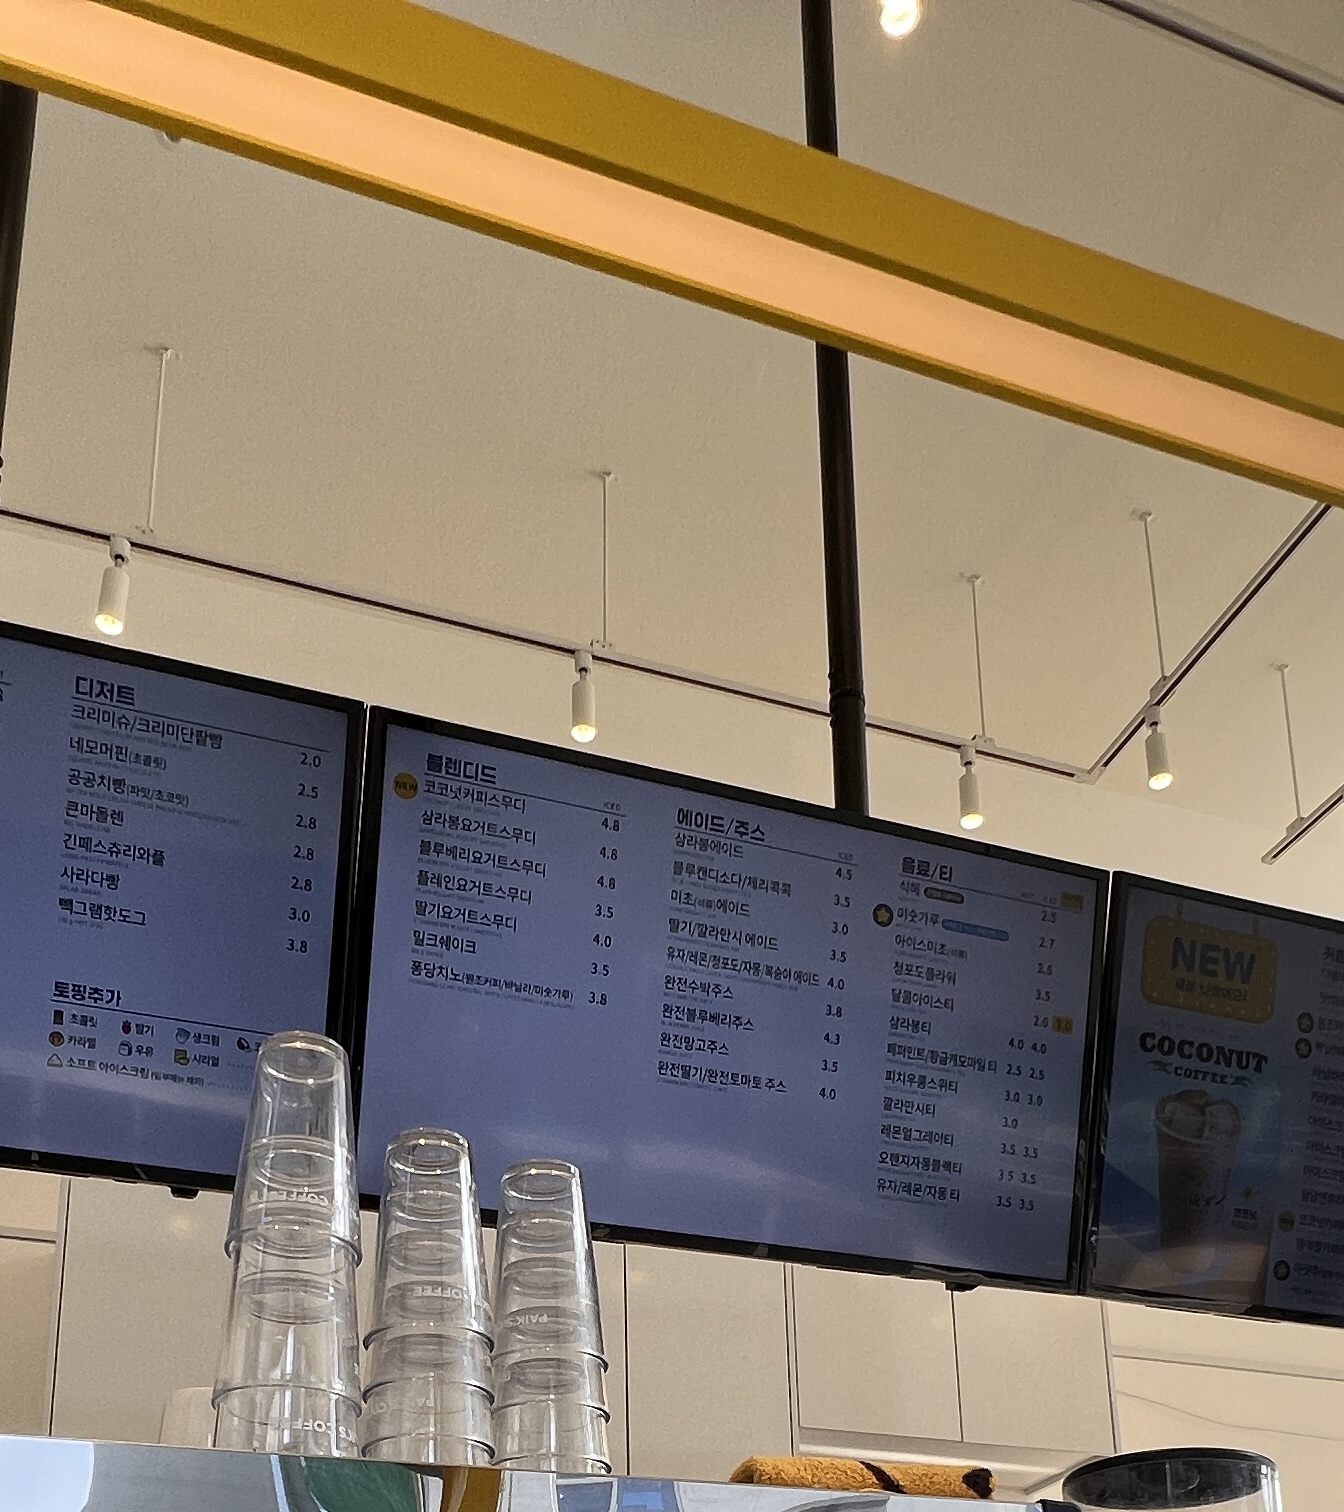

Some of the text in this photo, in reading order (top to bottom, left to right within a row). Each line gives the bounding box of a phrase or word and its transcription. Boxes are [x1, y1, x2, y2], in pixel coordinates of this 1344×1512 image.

[75, 676, 136, 707] 디저트
[71, 704, 223, 750] 크리미슈/크리미단팥빵
[426, 753, 497, 785] 블렌디드
[423, 779, 526, 814] 코코넛커피스무디
[65, 800, 124, 826] 큰마들렌
[676, 807, 765, 842] 에이드/주스
[419, 840, 547, 878] 블루베리요거트스무디
[60, 866, 120, 891] 사라다빵
[416, 869, 532, 905] 플레인요거트스무디
[414, 899, 518, 935] 딸기요거트스무디
[412, 929, 477, 955] 밀크쉐이크
[744, 932, 779, 951] 에이드
[1171, 935, 1255, 986] NEW
[53, 981, 122, 1007] 토핑추가
[664, 974, 734, 1000] 완전수박주스
[69, 1013, 98, 1028] 초콜릿
[662, 1002, 755, 1033] 완전블루베리주스
[659, 1032, 730, 1056] 완전망고주스
[1138, 1032, 1269, 1075] COCONUT
[65, 1057, 150, 1079] 소프트 아이스크림
[192, 1054, 219, 1067] 시리얼
[1174, 1065, 1230, 1086] COFFEE
[657, 1060, 787, 1094] 완전딸기/완전토마토 주스
